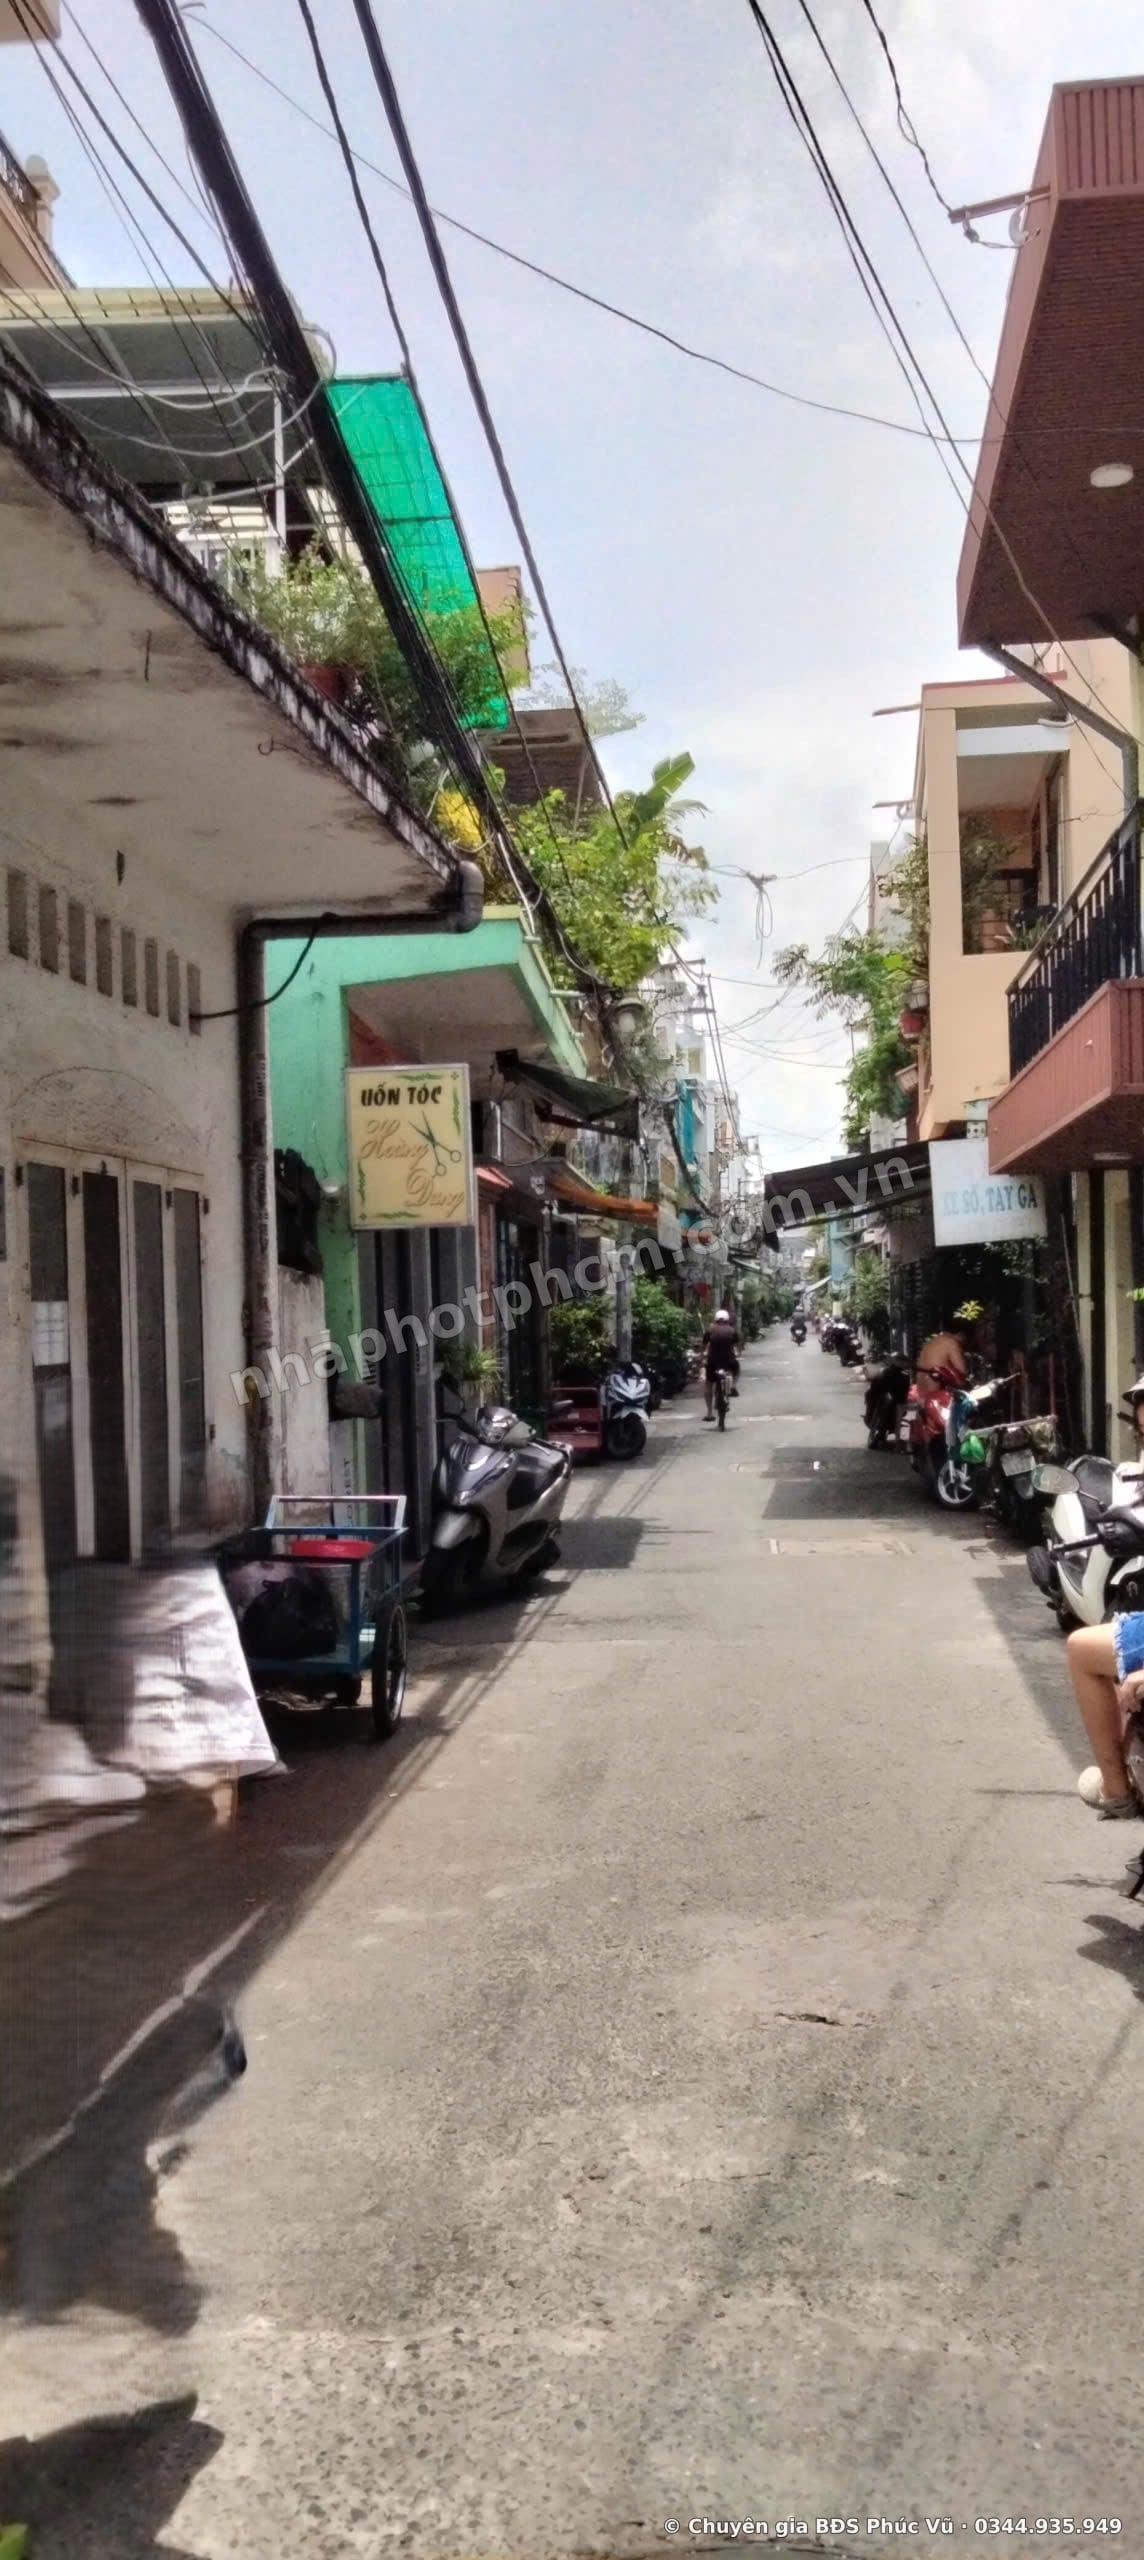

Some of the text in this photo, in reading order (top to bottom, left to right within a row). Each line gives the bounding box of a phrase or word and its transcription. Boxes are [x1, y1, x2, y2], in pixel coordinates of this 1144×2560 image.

[361, 1081, 442, 1106] UỐN TÓC
[985, 1185, 1014, 1213] TAY
[1017, 1183, 1039, 1209] GA
